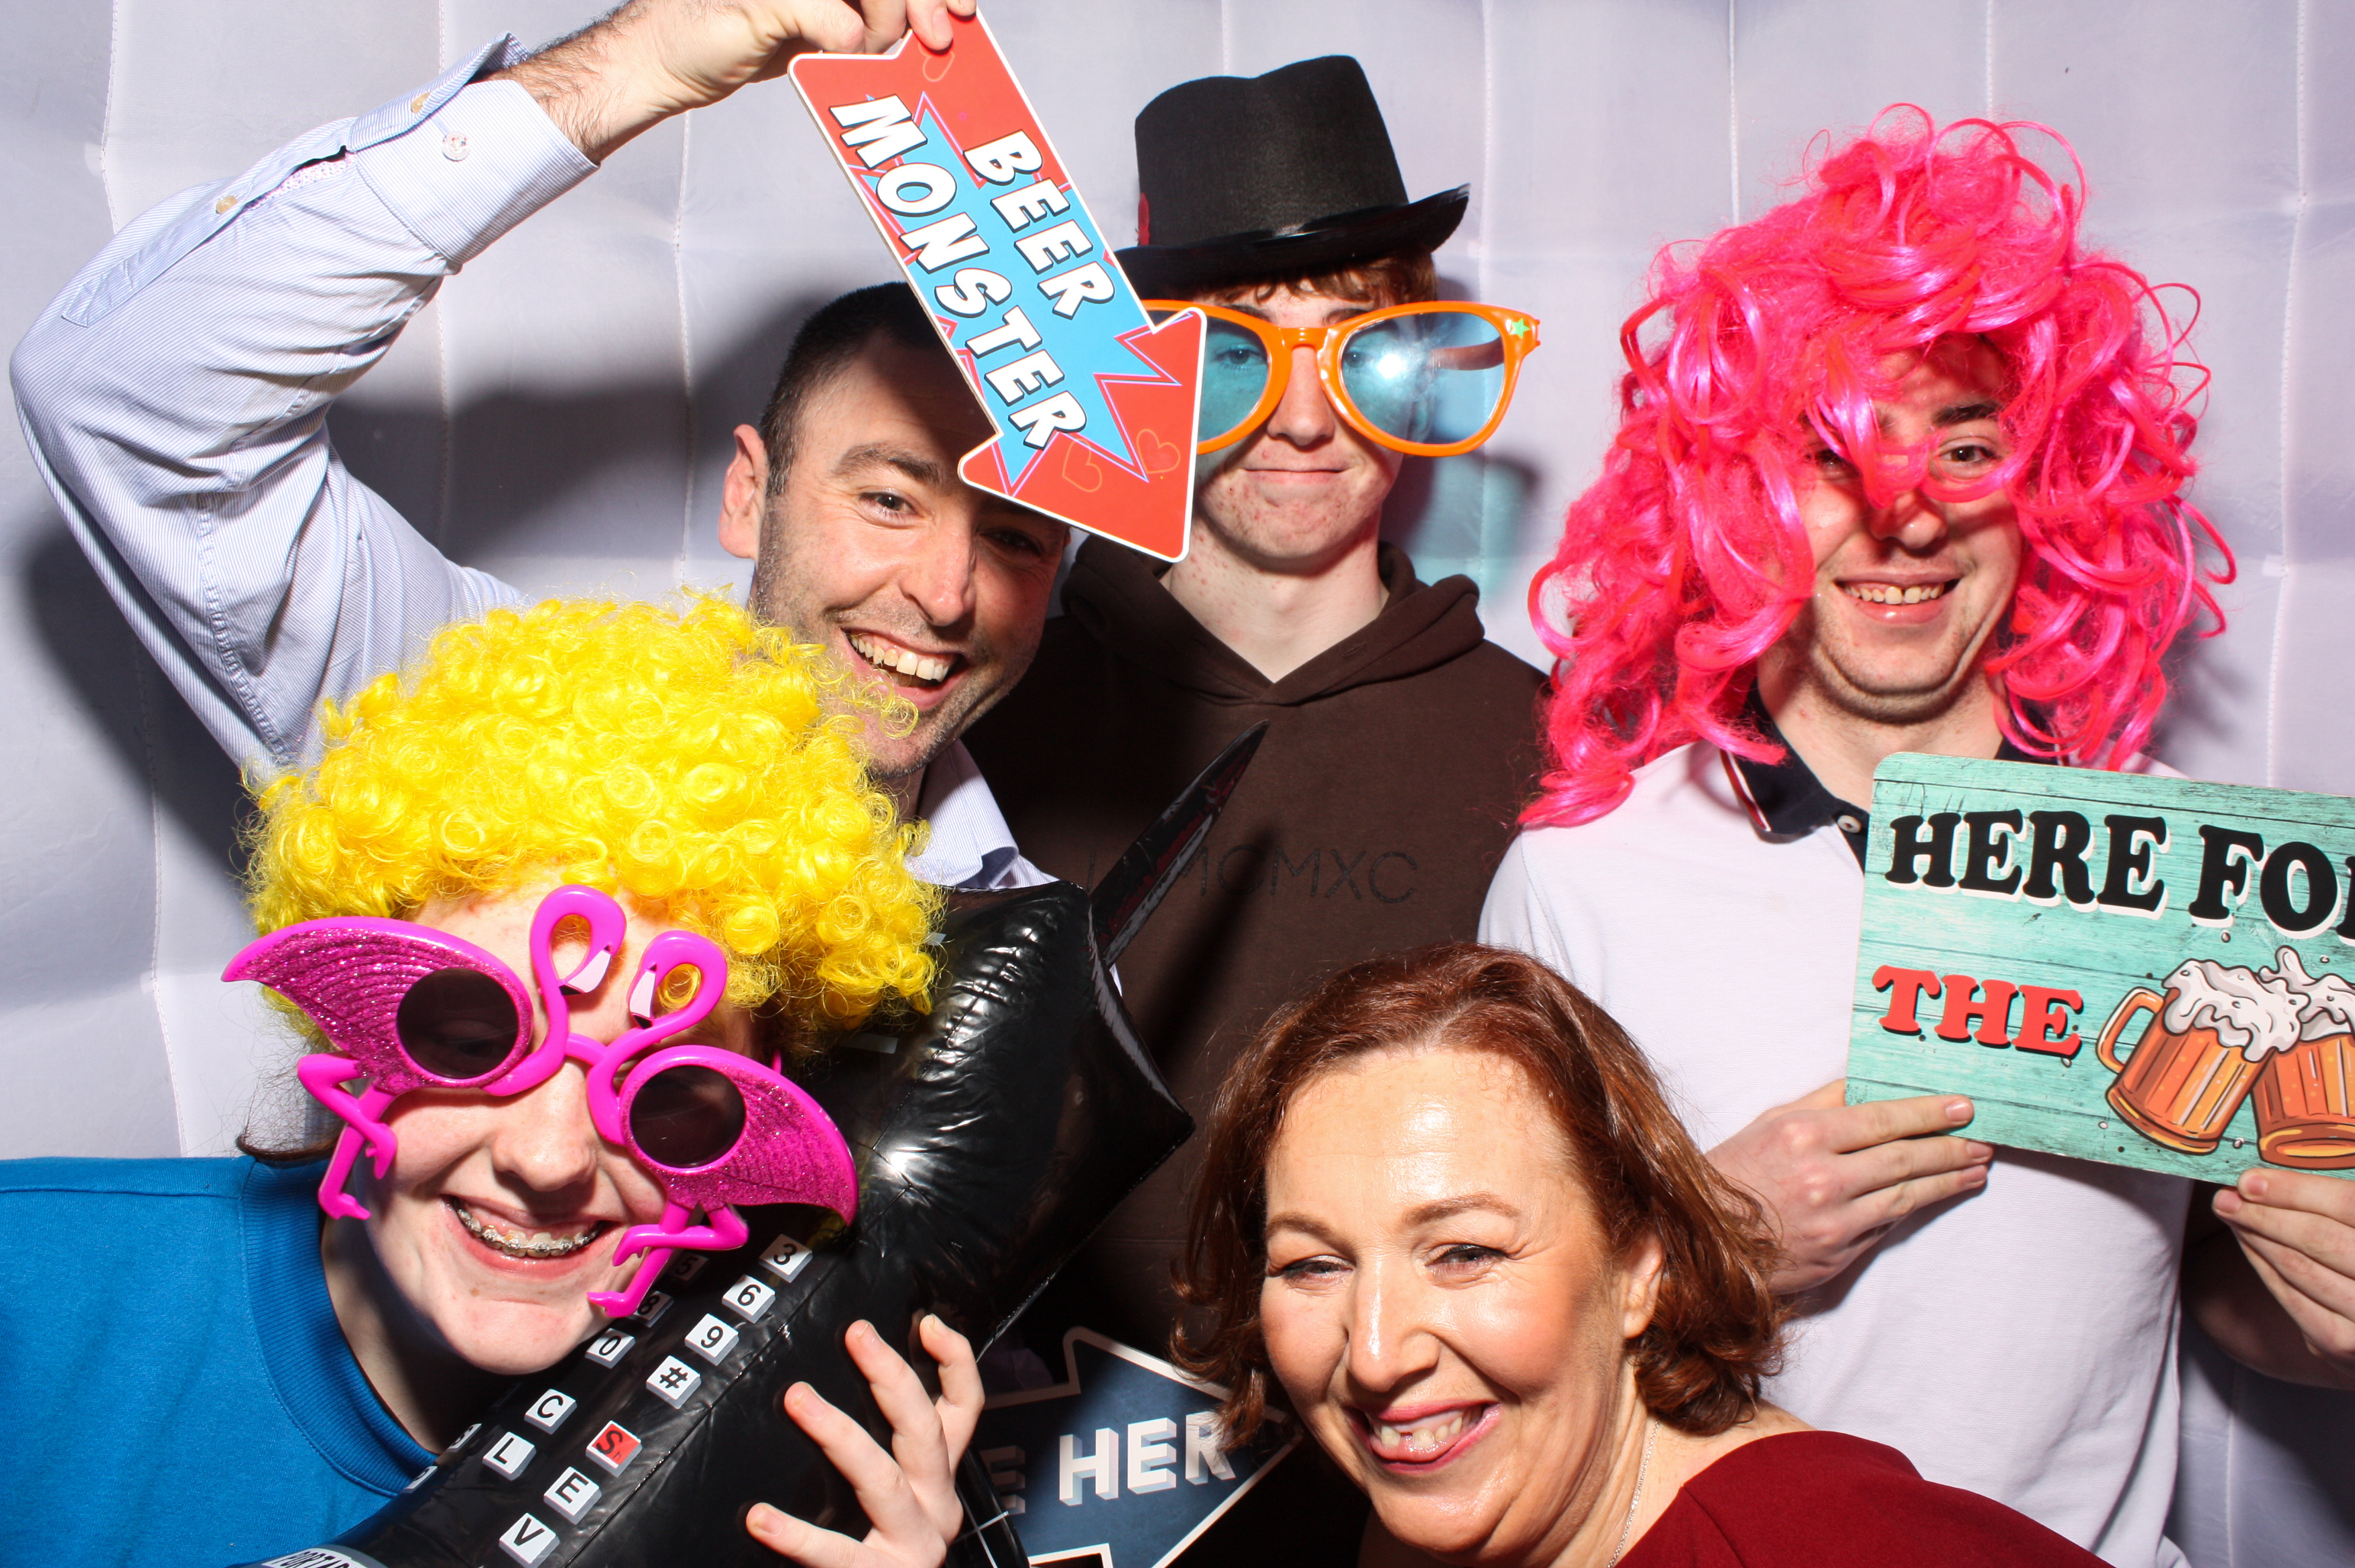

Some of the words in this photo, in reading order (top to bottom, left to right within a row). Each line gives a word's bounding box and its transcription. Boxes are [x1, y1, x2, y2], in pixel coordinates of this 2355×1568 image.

[963, 129, 1116, 319] BEER
[829, 93, 1088, 449] MONSTER
[1884, 808, 2170, 919] HERE
[1871, 964, 2084, 1059] THE
[773, 1242, 798, 1267] 3
[737, 1284, 763, 1307] 6
[699, 1325, 724, 1349] 9
[537, 1394, 564, 1420] C
[492, 1437, 516, 1466] L
[554, 1471, 590, 1504] E
[513, 1517, 546, 1548] V
